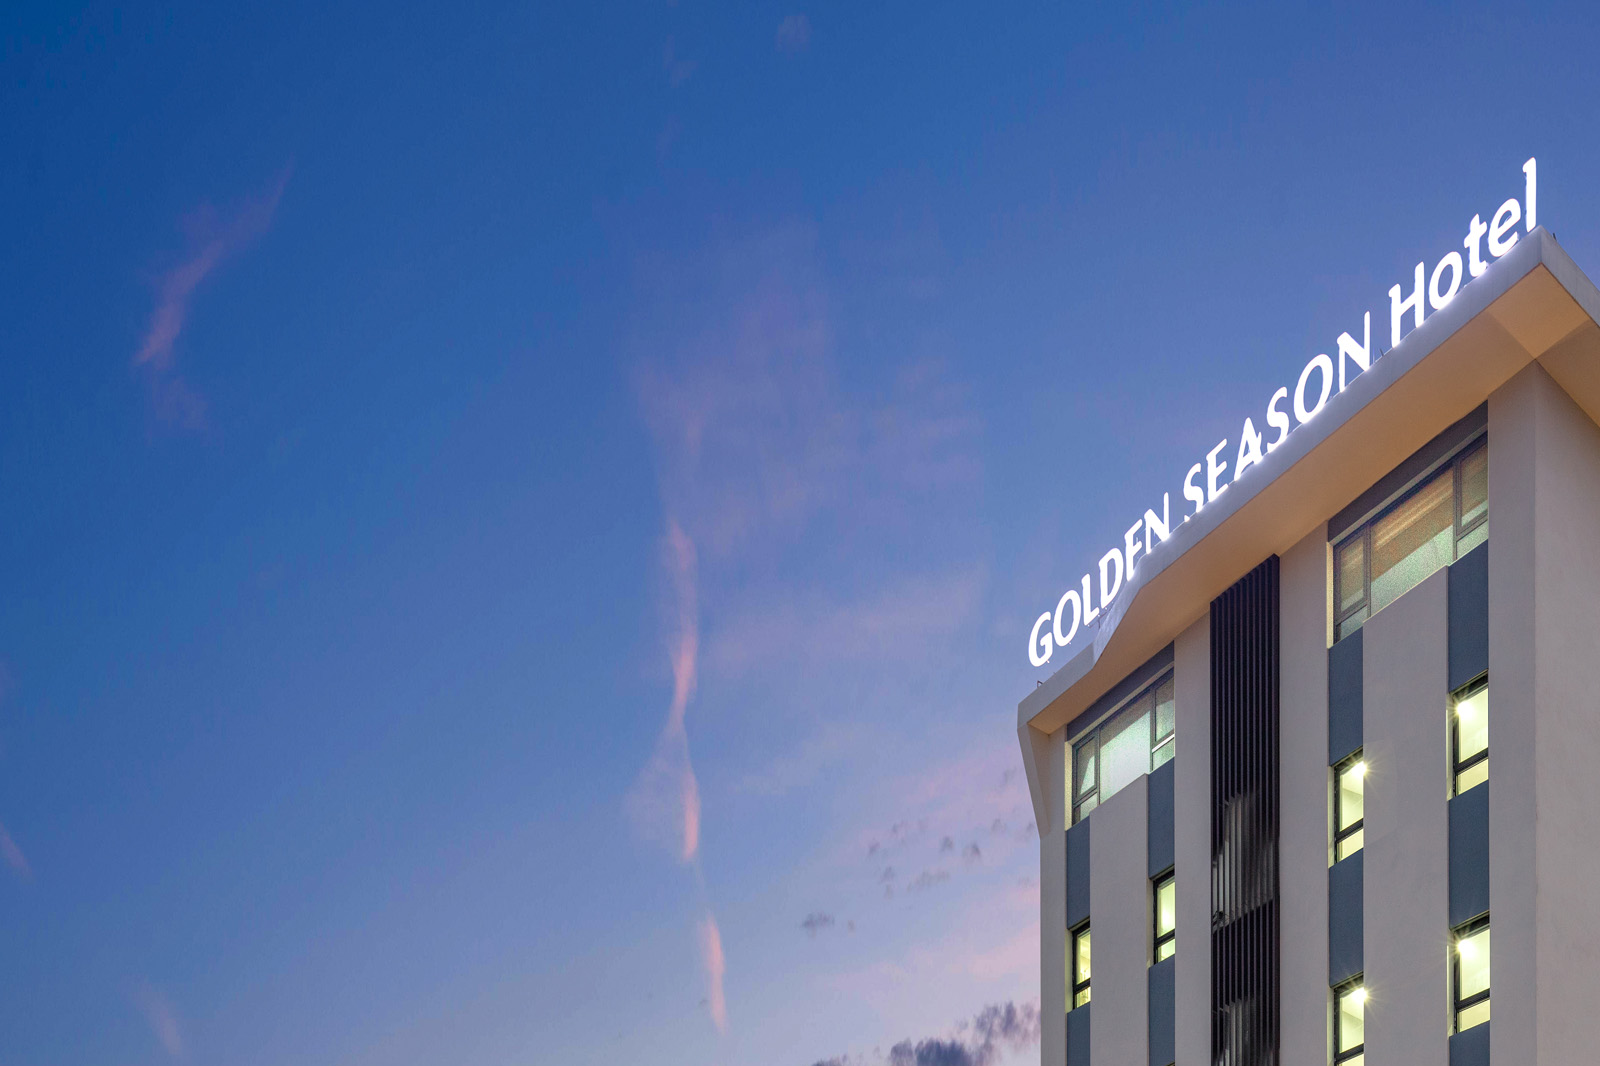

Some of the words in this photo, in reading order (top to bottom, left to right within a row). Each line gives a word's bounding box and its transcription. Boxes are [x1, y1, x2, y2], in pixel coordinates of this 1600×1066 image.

[1028, 491, 1170, 667] GOLDEN
[1183, 311, 1370, 522] SEASON
[1388, 157, 1537, 348] Hotel
